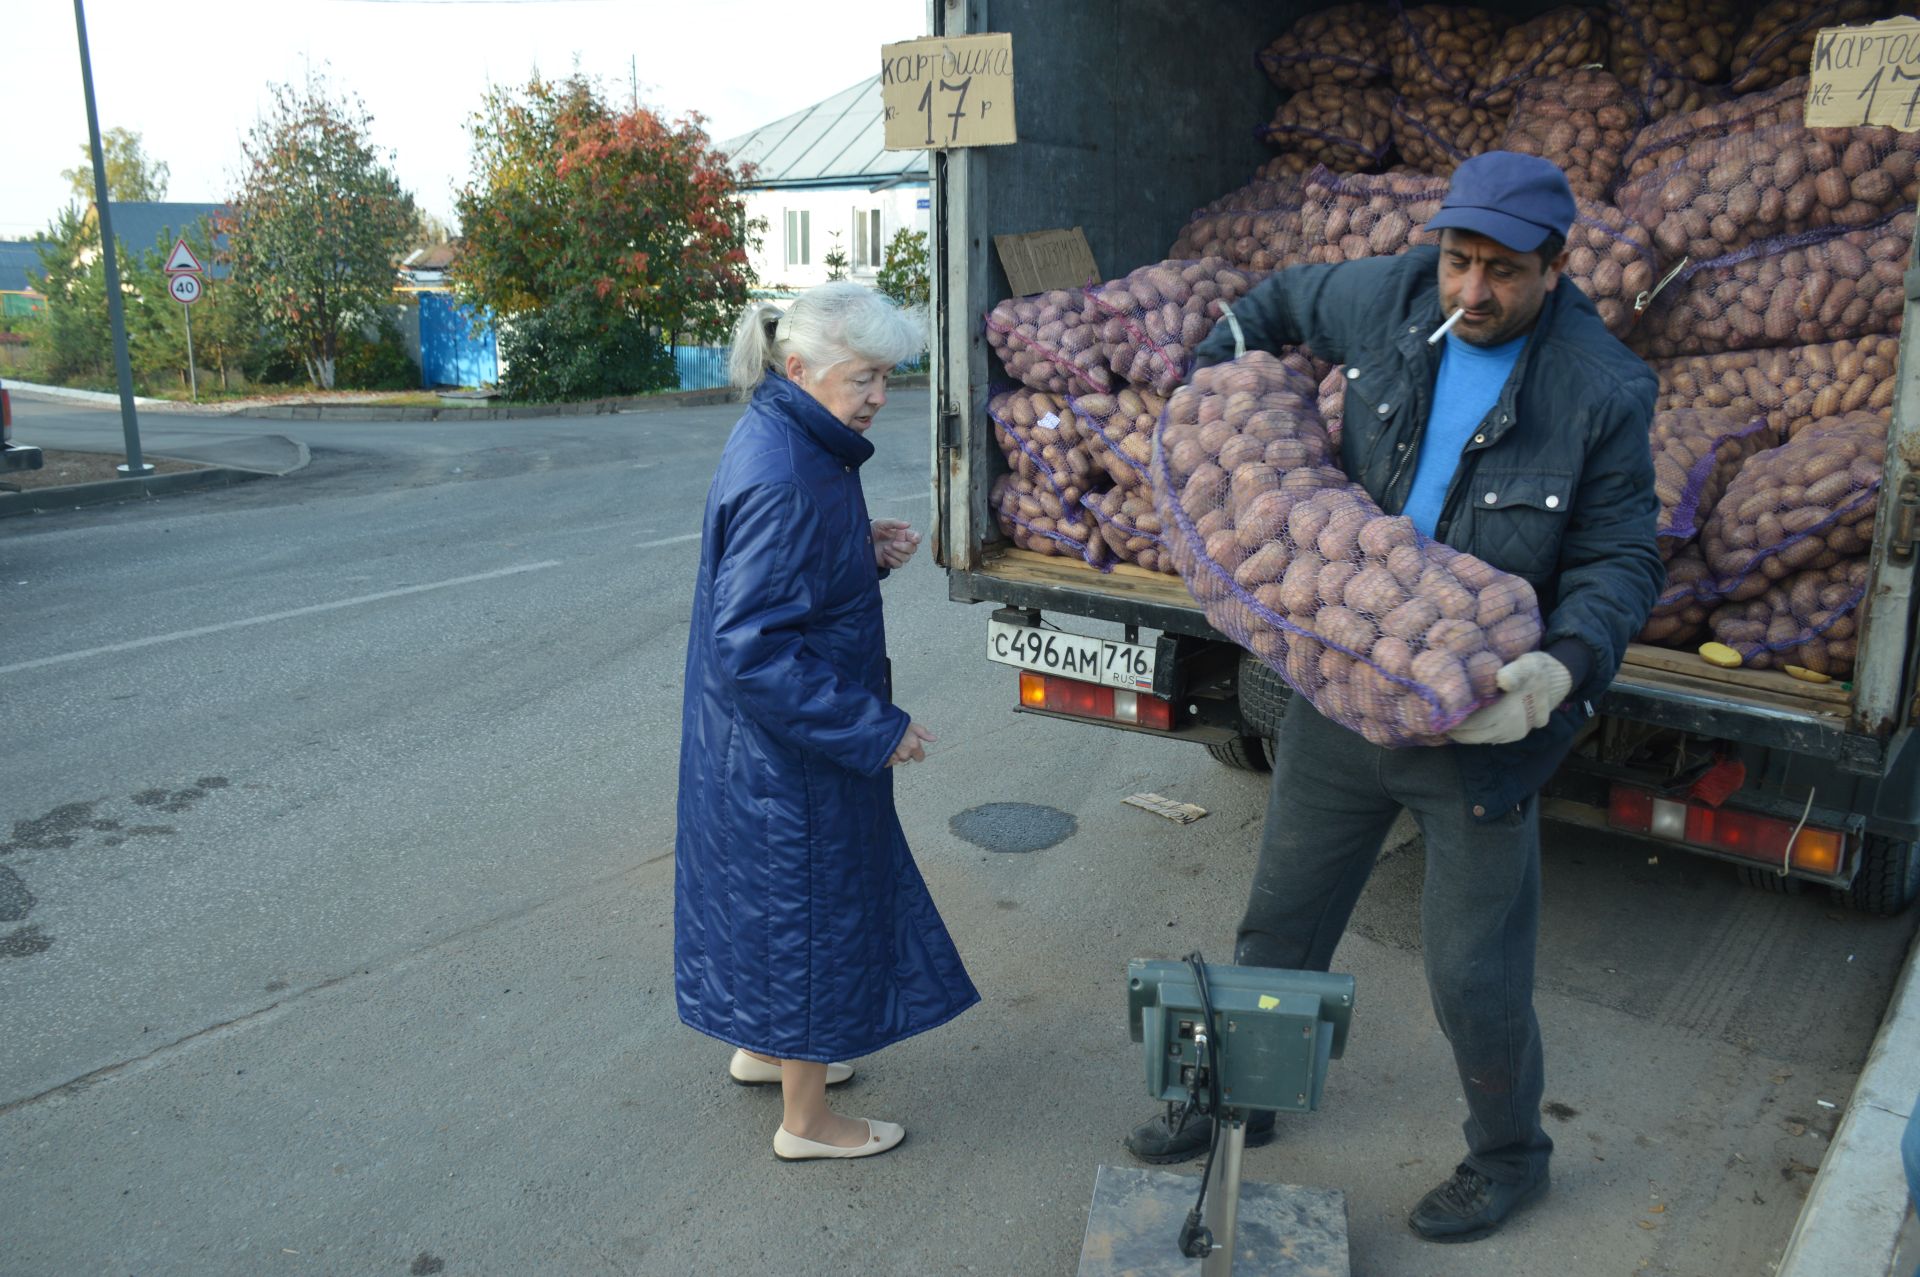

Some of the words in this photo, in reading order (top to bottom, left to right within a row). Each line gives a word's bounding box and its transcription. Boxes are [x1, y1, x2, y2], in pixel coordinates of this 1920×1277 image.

[918, 77, 972, 145] 17
[176, 282, 194, 294] 40
[1104, 644, 1148, 675] 716
[1113, 672, 1135, 685] RUS
